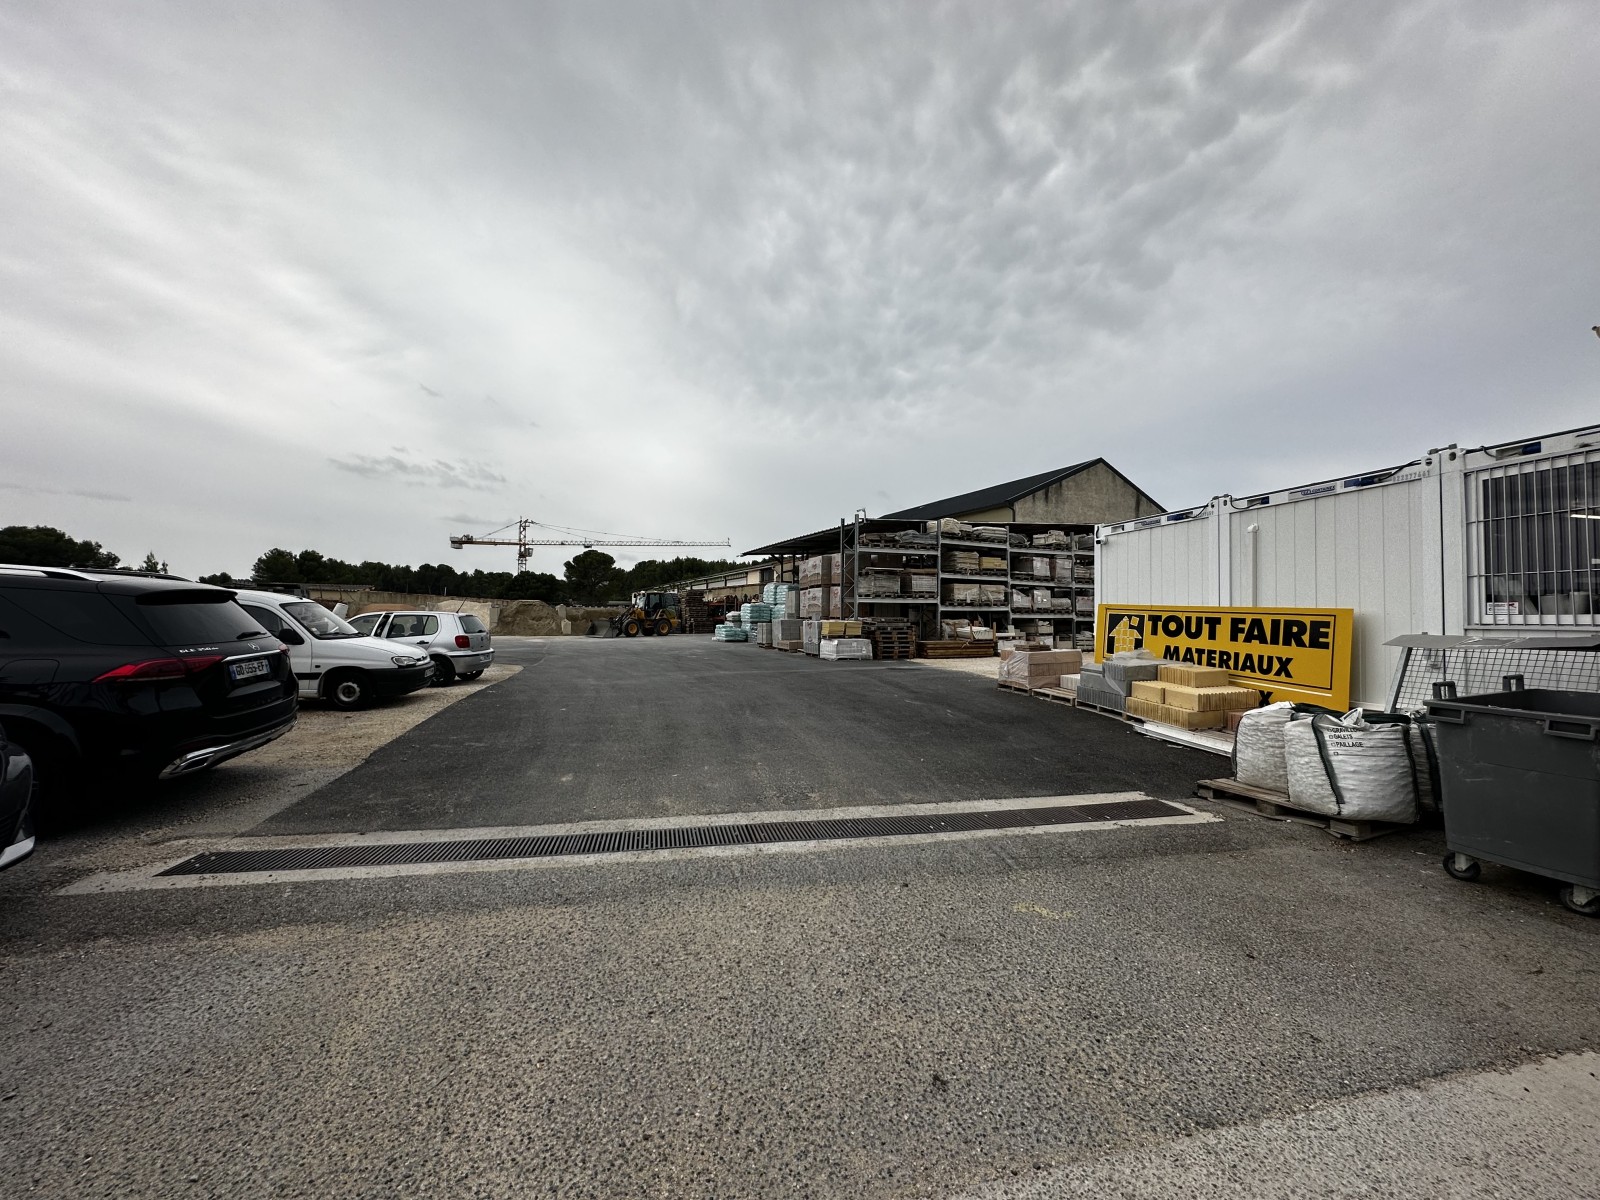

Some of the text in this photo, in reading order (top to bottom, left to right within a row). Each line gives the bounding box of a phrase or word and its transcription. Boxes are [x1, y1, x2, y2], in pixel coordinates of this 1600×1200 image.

[1148, 614, 1331, 650] TOUT FAIRE
[1162, 644, 1294, 679] MATERIAUX
